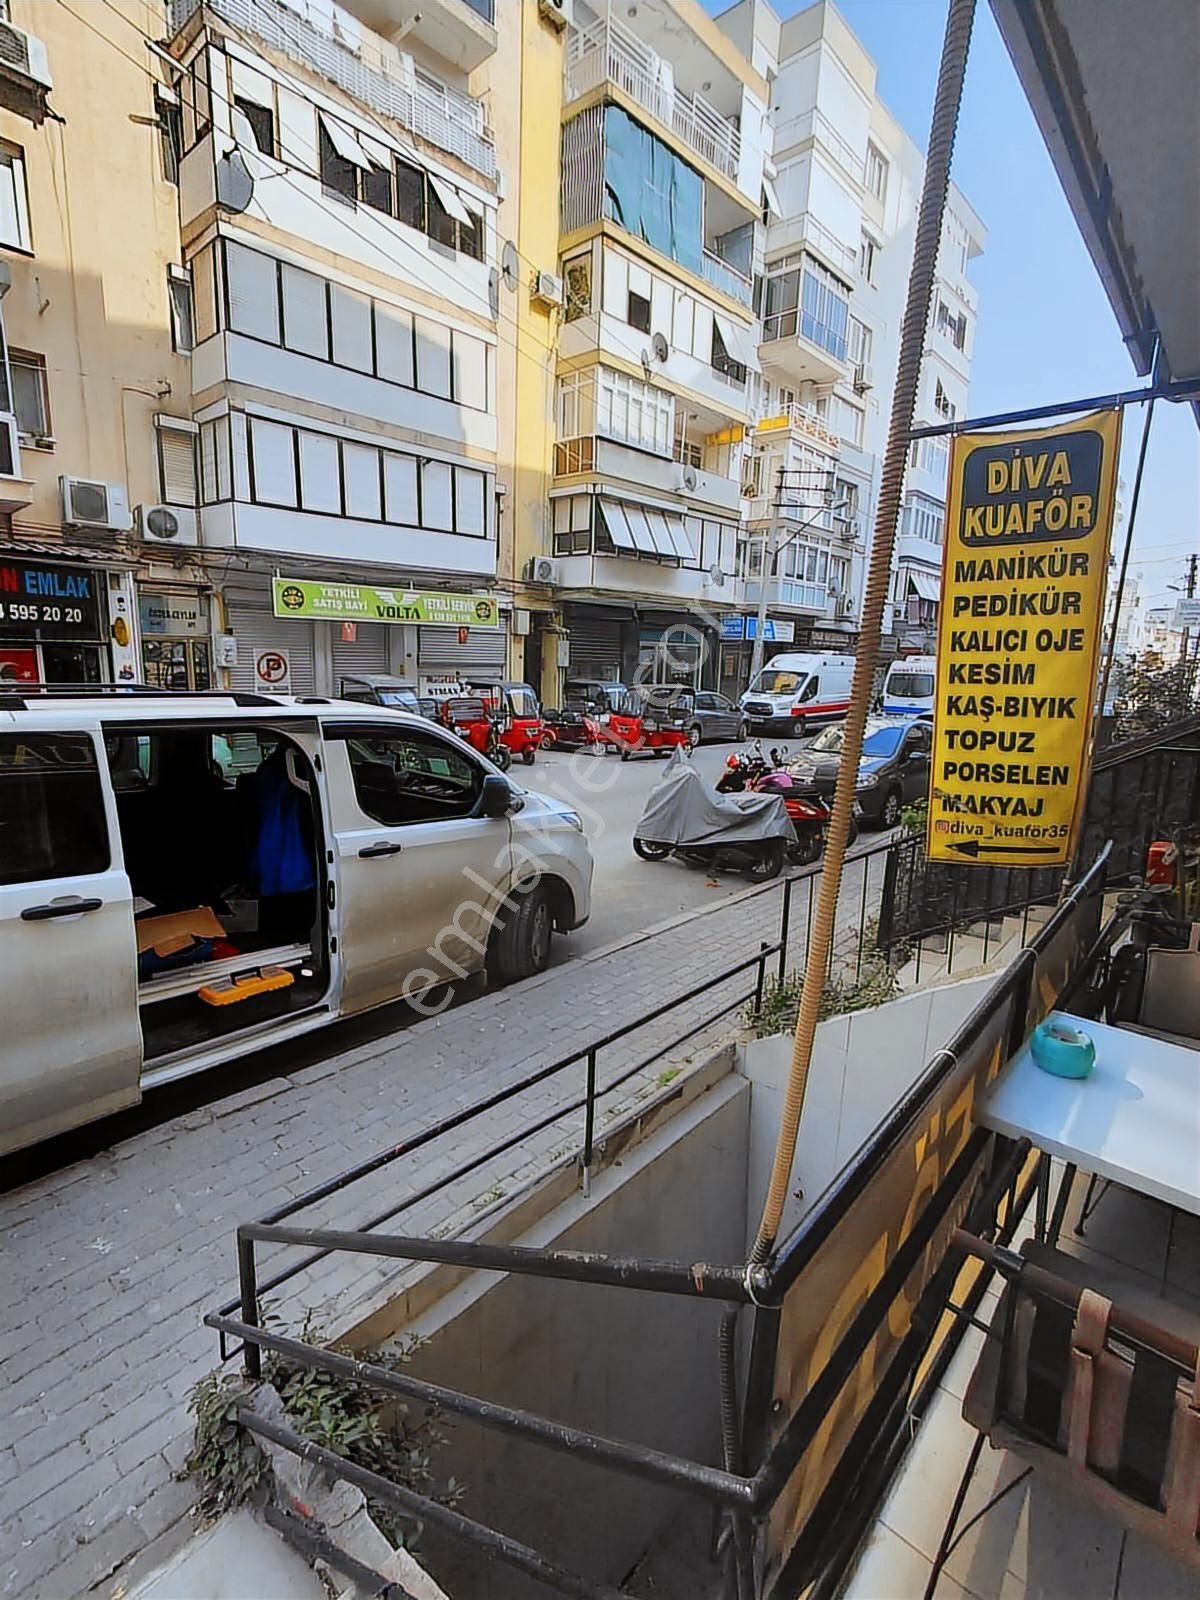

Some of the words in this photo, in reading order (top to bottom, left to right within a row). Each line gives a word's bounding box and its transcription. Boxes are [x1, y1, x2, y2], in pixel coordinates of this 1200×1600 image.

[987, 448, 1072, 495] DİVA
[964, 488, 1093, 539] KUAFÖR
[954, 547, 1089, 583] MANİKÜR
[24, 570, 91, 599] EMLAK
[9, 603, 38, 620] 595
[43, 606, 61, 621] 20
[65, 608, 82, 622] 20
[376, 605, 421, 620] VOLTA
[953, 586, 1082, 618] PEDİKÜR
[950, 629, 1027, 652] KALICI
[1035, 628, 1085, 652] OJE
[948, 657, 1036, 685] KESİM
[946, 695, 1077, 723] KAŞ-BIYIK
[944, 729, 1036, 753] TOPUZ
[943, 761, 1070, 785] PORSELEN
[942, 792, 1044, 817] MAKYAJ
[950, 820, 1069, 839] diva_kuaför35
